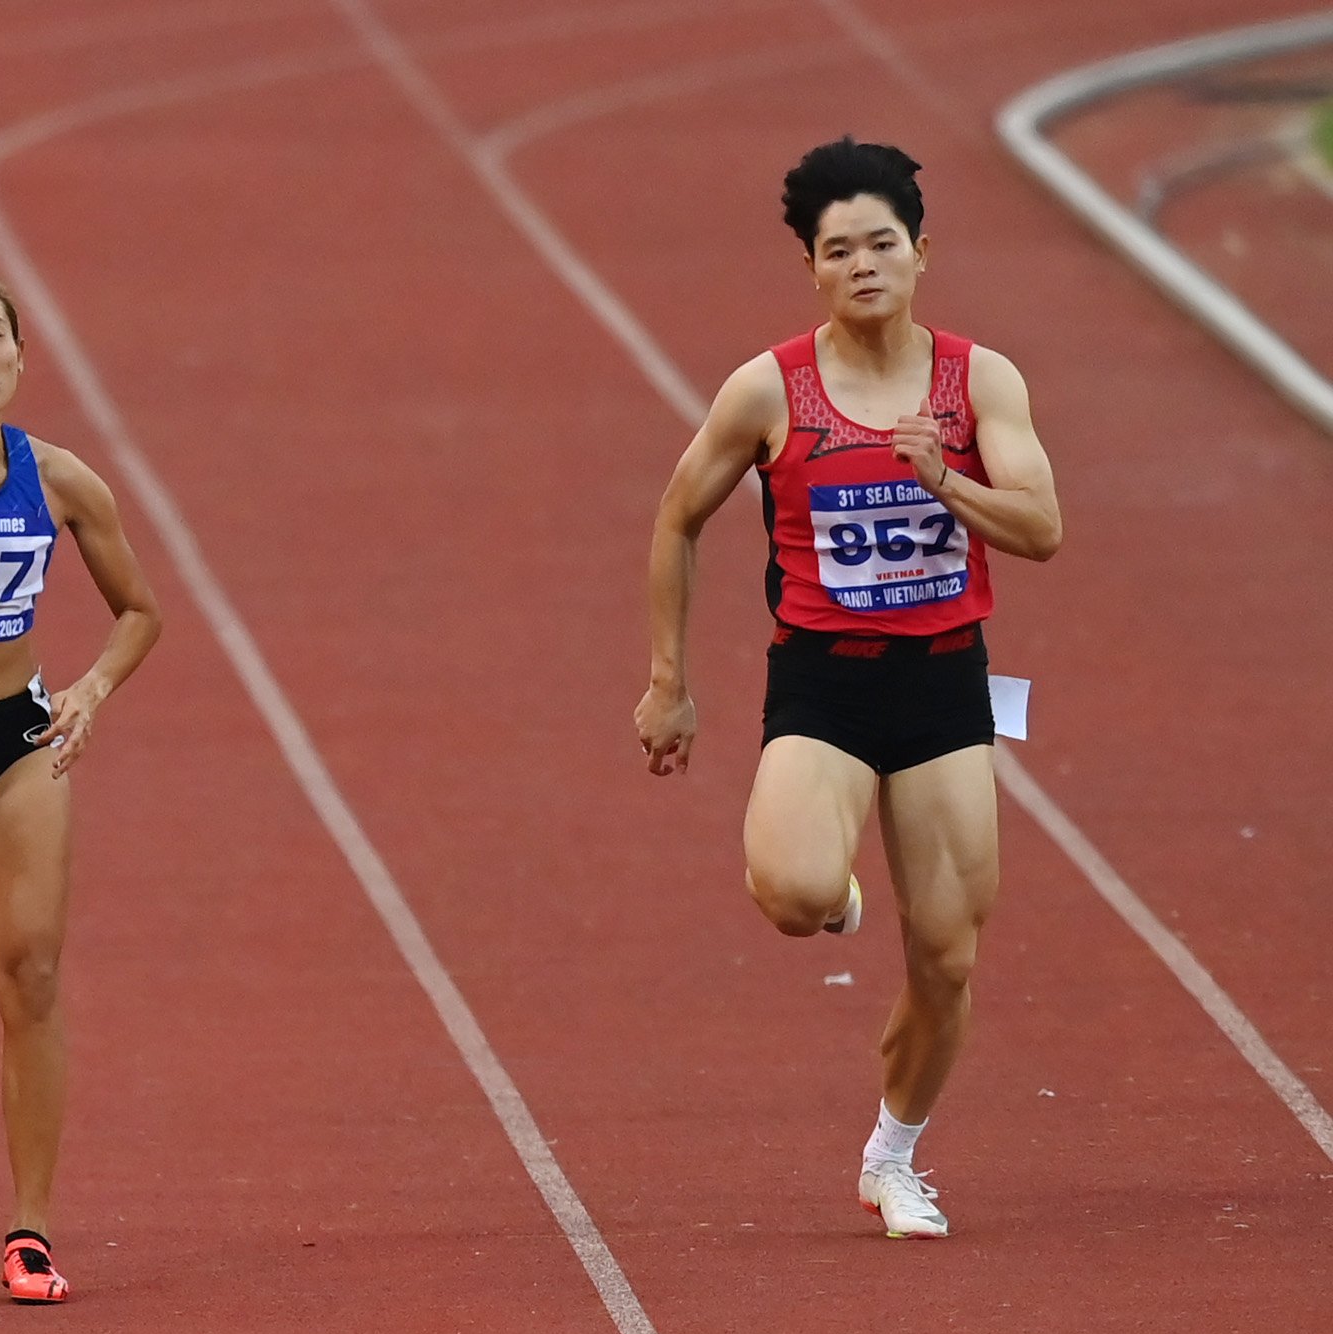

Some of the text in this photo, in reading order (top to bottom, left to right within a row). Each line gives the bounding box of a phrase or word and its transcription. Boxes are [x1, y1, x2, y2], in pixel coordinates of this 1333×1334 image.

[866, 485, 893, 505] SEA
[895, 483, 935, 502] Gam
[828, 512, 956, 566] 852
[883, 582, 935, 605] VIETNAM
[935, 576, 963, 598] 2022
[0, 617, 25, 638] 2022
